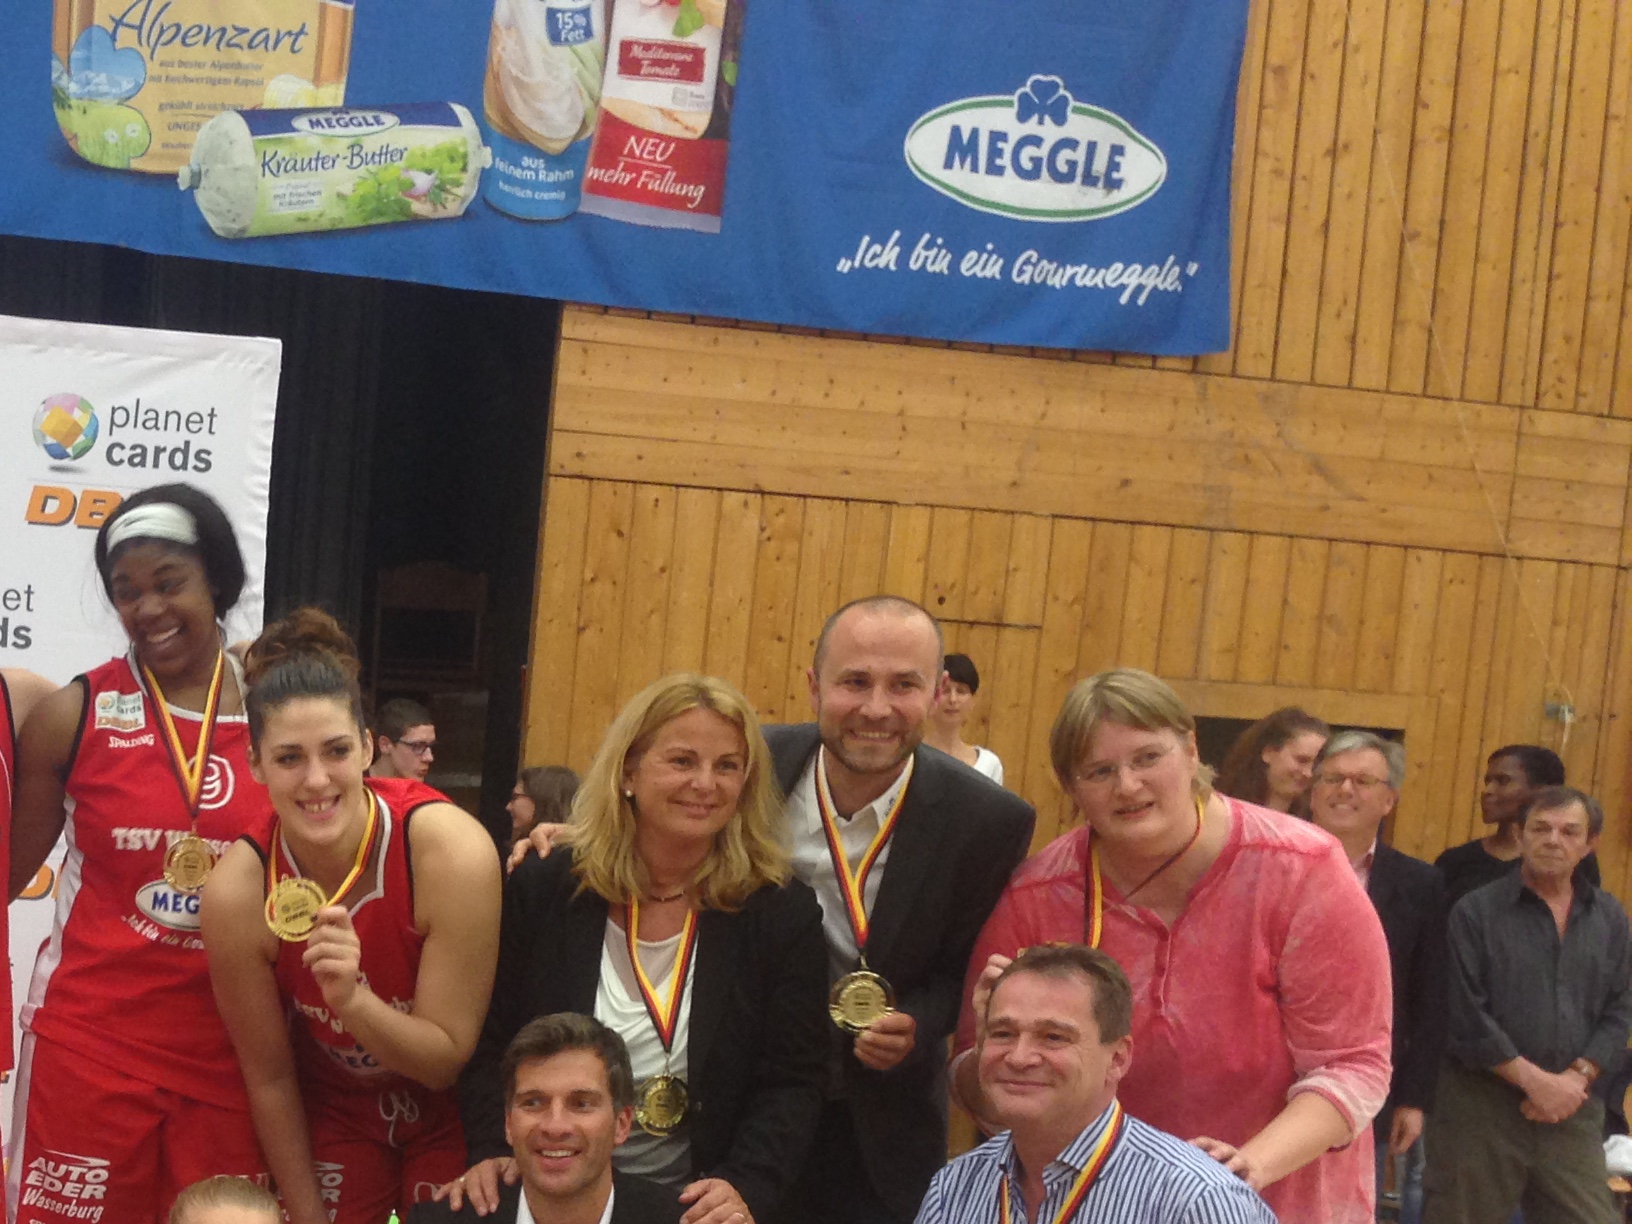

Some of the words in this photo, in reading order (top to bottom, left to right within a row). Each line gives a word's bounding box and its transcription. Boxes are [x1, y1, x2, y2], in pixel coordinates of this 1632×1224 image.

[109, 0, 310, 60] Alpenzart
[307, 112, 386, 130] MEGGLE
[261, 143, 409, 178] Kräuter-Butter
[623, 135, 676, 162] NEU
[942, 124, 1128, 191] MEGGLE
[538, 168, 575, 184] Rahm
[587, 162, 638, 188] mehr
[640, 169, 706, 209] Füllung
[908, 232, 950, 276] bin
[959, 243, 1005, 280] ein
[109, 398, 218, 436] planet
[105, 440, 213, 474] cards
[108, 733, 156, 748] SPALDING
[111, 828, 163, 851] TSV
[25, 1171, 108, 1201] EDER
[28, 1156, 111, 1184] AUTO
[22, 1187, 105, 1224] Wasserburg
